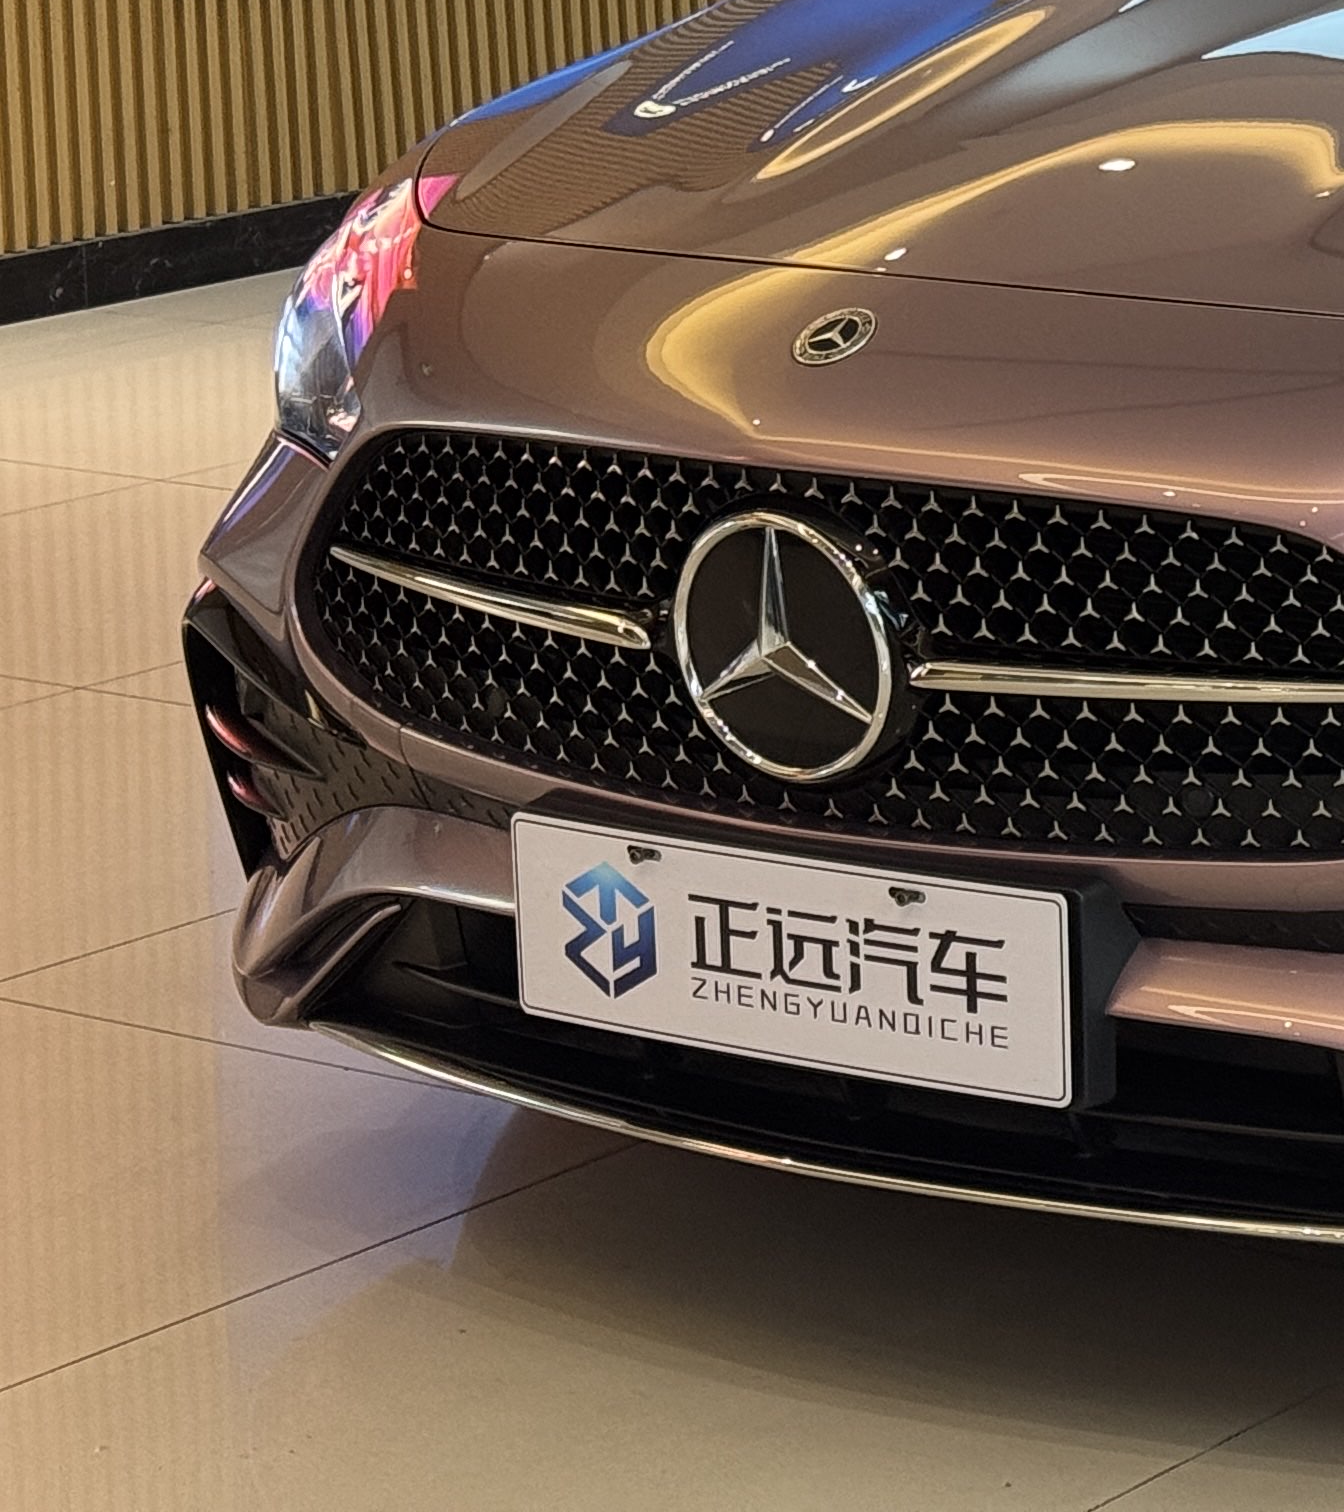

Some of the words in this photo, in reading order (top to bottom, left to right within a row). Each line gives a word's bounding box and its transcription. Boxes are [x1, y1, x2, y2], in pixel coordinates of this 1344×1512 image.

[687, 892, 1009, 1015] 正远汽车
[691, 976, 1010, 1051] ZHENGYUANQICHE
